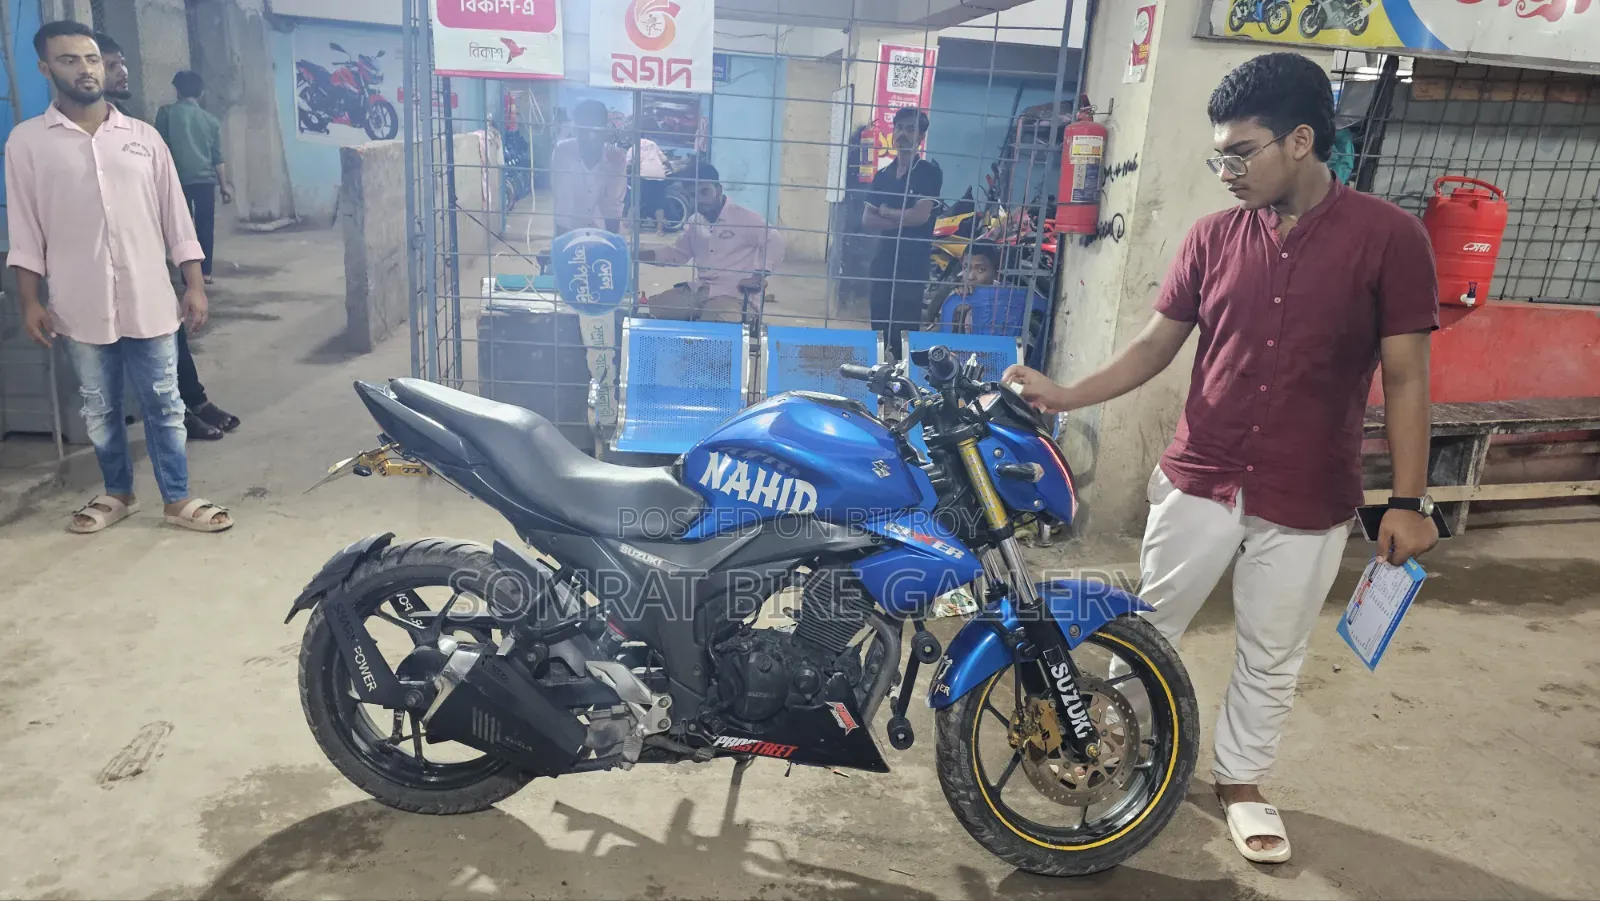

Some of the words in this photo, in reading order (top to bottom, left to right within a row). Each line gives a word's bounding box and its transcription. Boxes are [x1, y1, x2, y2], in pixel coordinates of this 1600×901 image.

[469, 41, 504, 60] বিকাশ
[610, 52, 693, 89] নগদ
[1462, 242, 1492, 253] সেরা
[698, 451, 818, 515] NAHID
[620, 543, 663, 567] SUZUKI
[354, 645, 378, 693] POWER
[1050, 661, 1094, 739] SUZUKI
